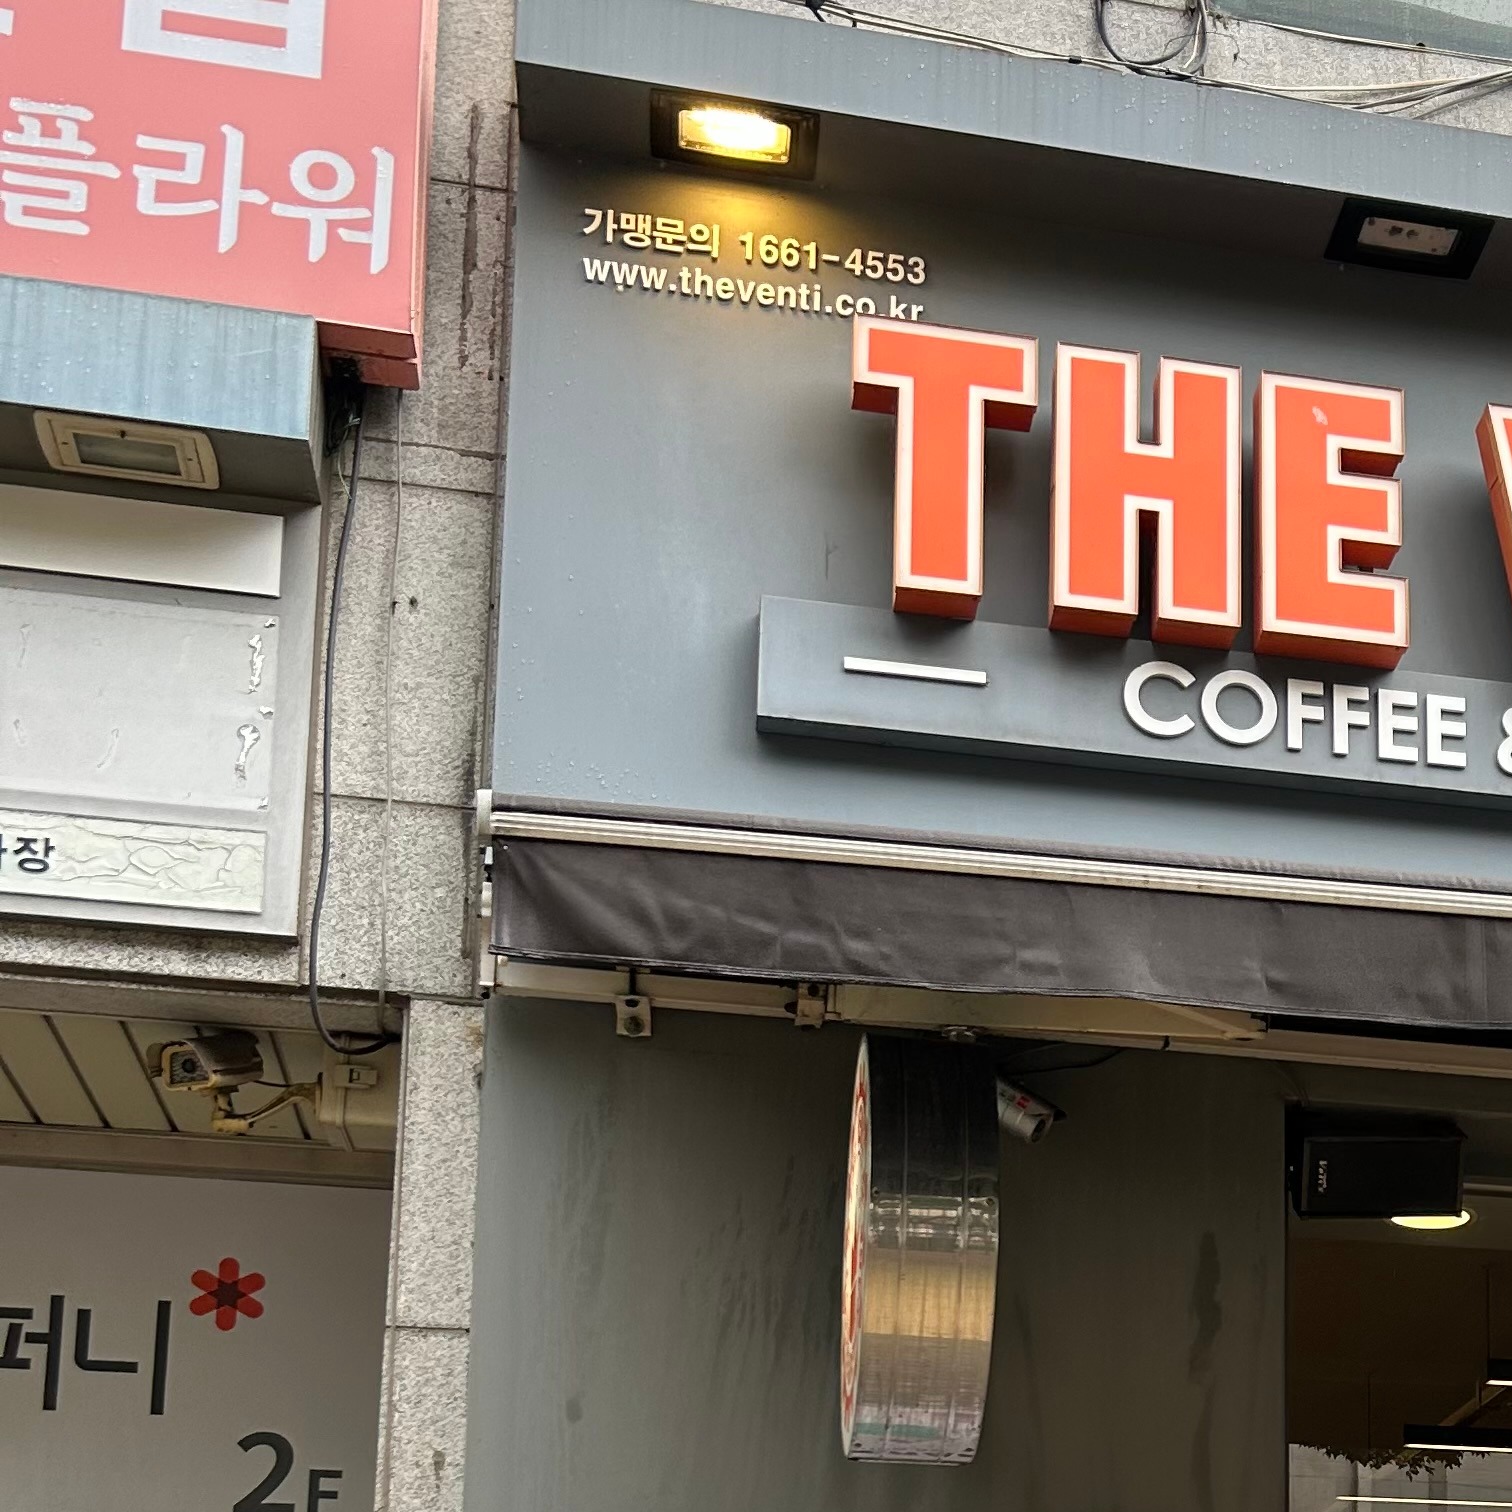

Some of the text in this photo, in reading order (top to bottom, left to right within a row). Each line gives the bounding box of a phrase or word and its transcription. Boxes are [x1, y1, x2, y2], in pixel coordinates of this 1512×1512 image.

[0, 98, 396, 276] 플라워
[583, 207, 926, 287] 가맹문의 1661-4553
[852, 312, 1410, 670] THE
[1122, 661, 1467, 770] COFFEE
[0, 834, 56, 873] 장
